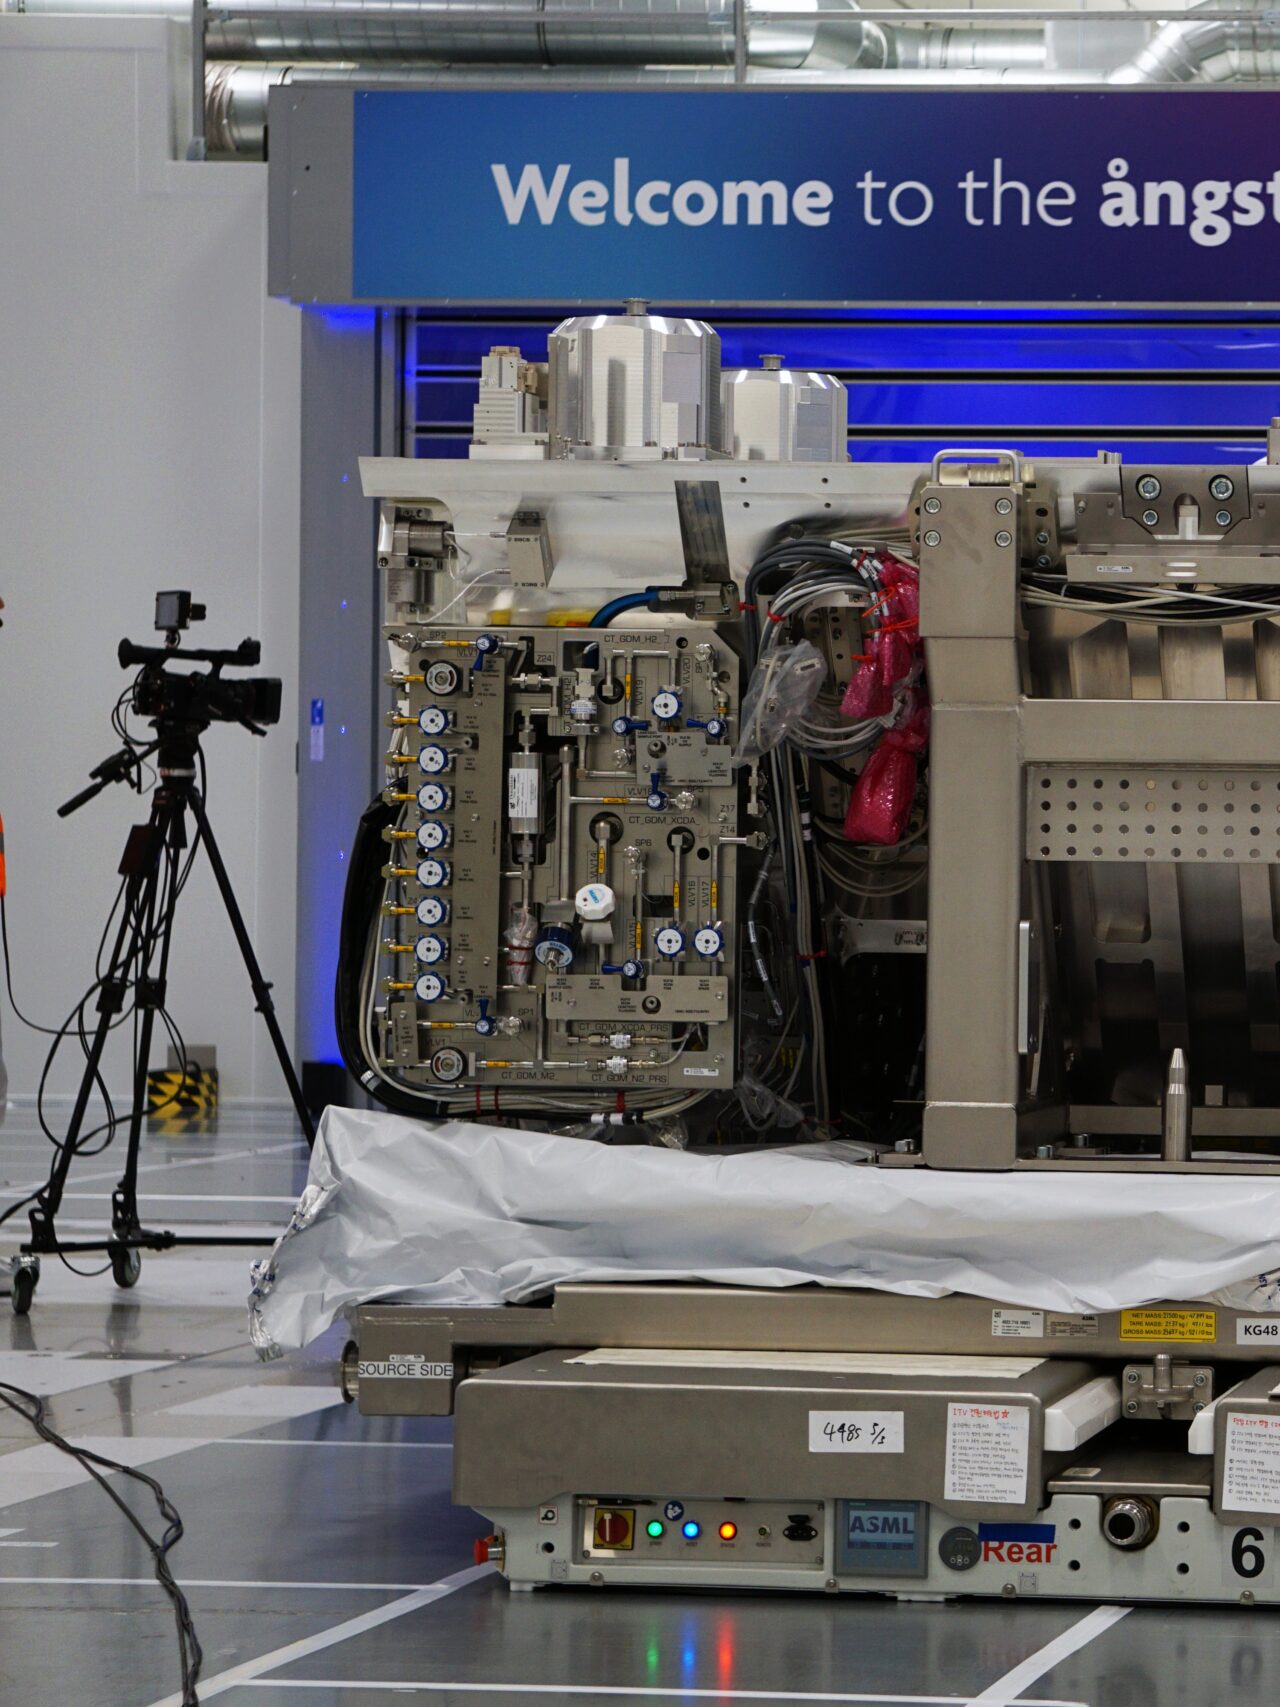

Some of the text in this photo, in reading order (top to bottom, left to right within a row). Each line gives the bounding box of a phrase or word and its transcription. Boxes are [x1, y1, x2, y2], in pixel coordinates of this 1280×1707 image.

[490, 157, 834, 228] Welcome
[856, 170, 934, 228] to
[957, 157, 1077, 228] the
[720, 825, 736, 834] Z14
[1244, 1325, 1279, 1336] KG48
[359, 1363, 453, 1377] SOURCE SIDE
[849, 1515, 915, 1534] ASML
[983, 1541, 1057, 1563] Rear
[1231, 1526, 1265, 1579] 6
